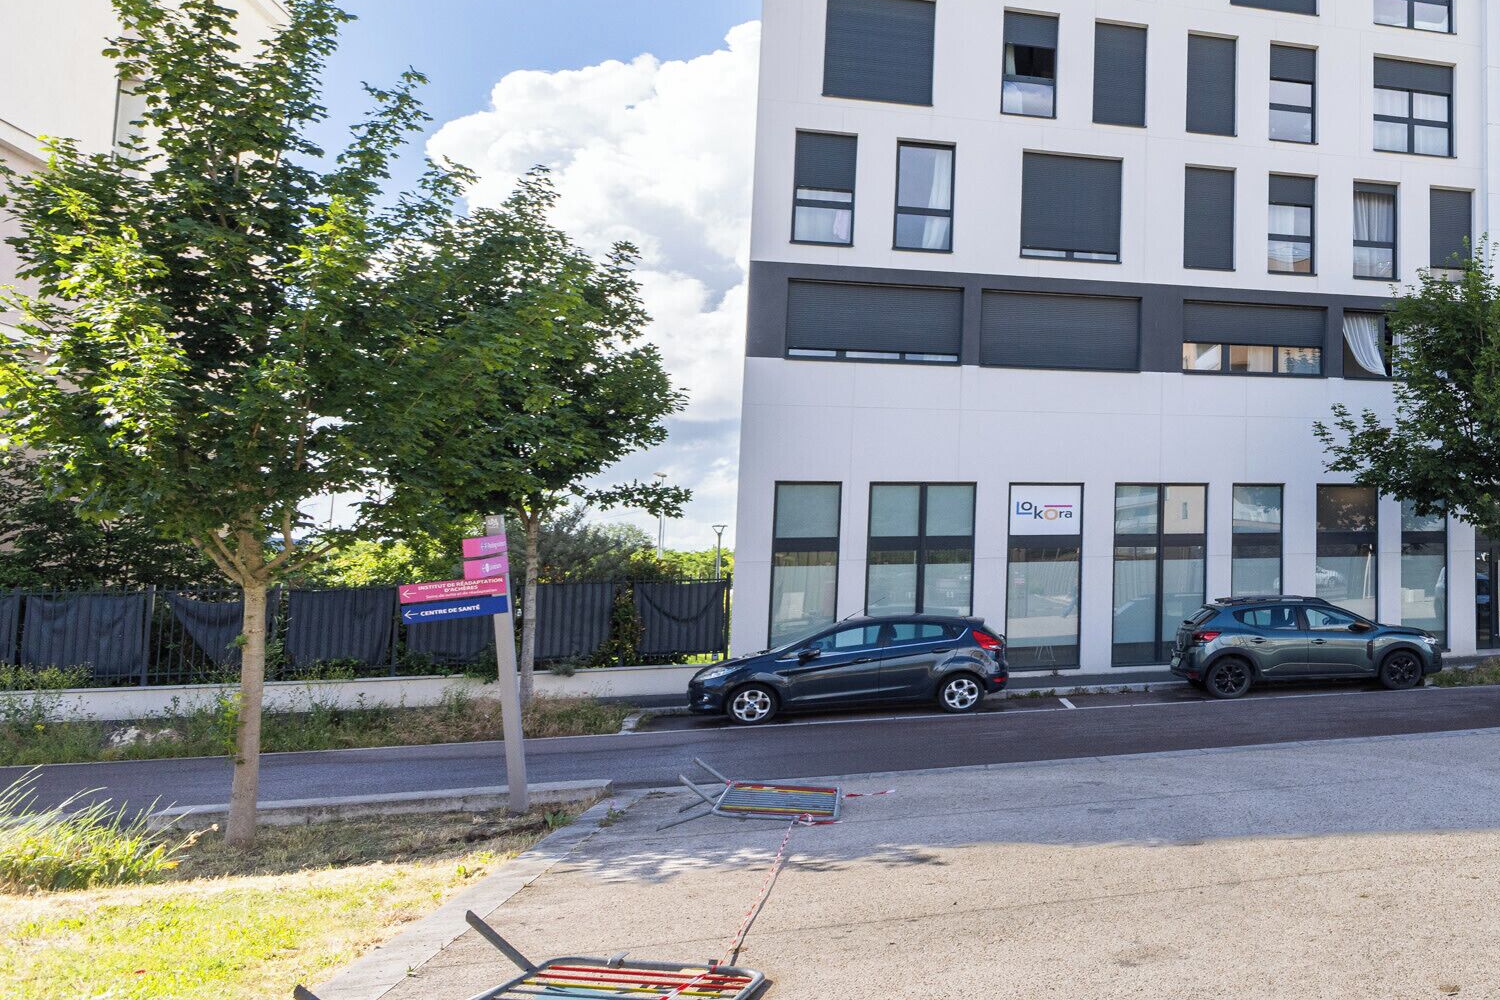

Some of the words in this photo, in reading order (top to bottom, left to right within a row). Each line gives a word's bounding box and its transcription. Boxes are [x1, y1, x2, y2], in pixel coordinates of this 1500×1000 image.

[417, 583, 446, 591] INSTITUT
[455, 577, 503, 587] RÉADAPTATION
[444, 584, 478, 593] D'ACHÈRES
[420, 608, 448, 617] CENTRE
[457, 604, 480, 613] SANTÉ
